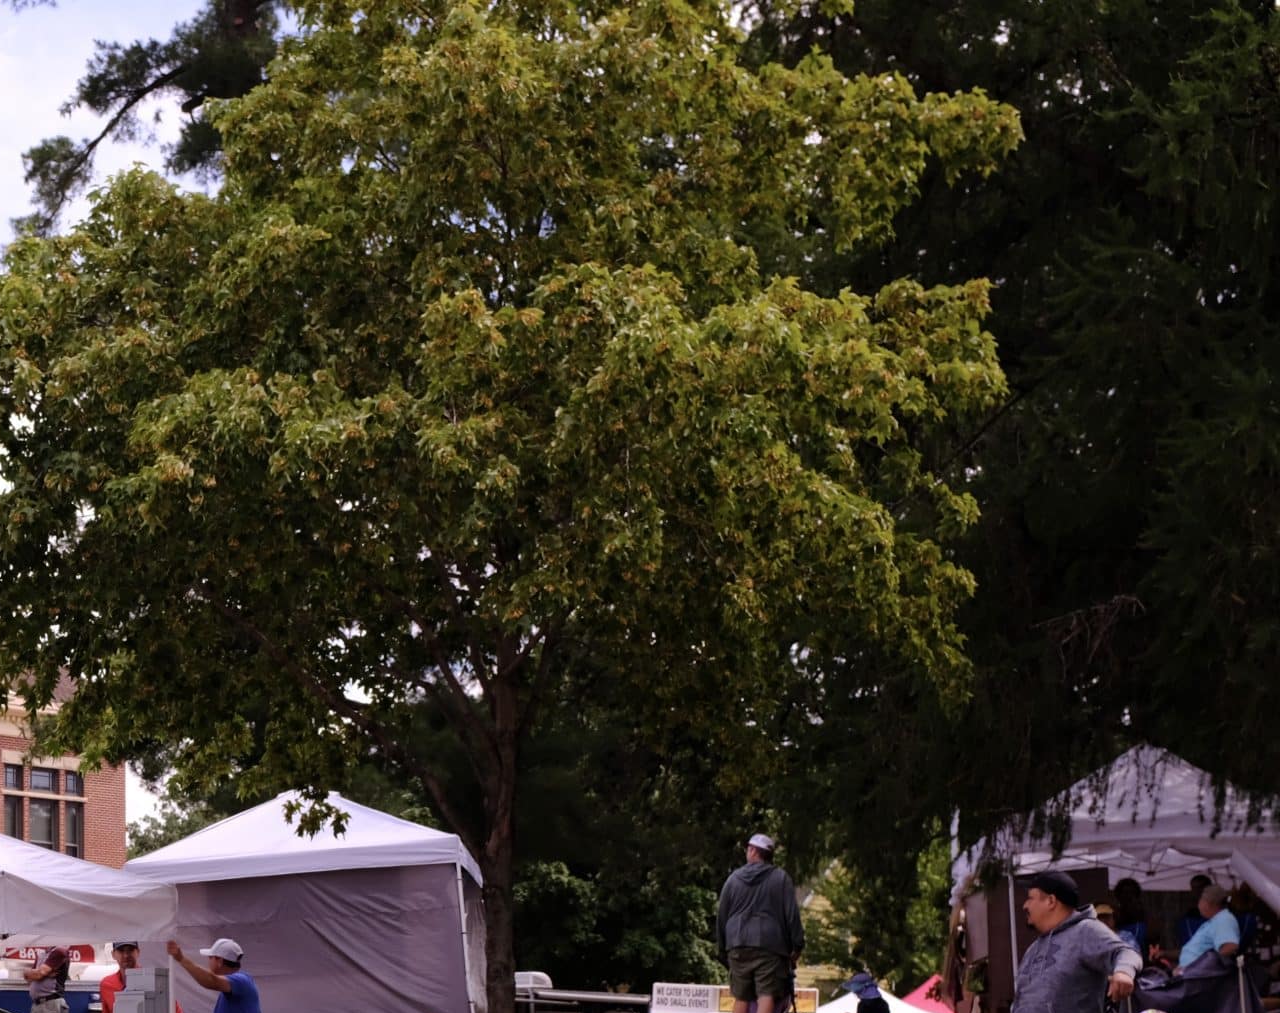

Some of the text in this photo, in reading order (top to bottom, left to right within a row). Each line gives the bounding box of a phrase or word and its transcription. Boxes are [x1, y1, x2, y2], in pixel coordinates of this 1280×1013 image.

[656, 986, 709, 999] WE CATER TO LARGE
[656, 997, 709, 1009] AND SMALL EVENTS
